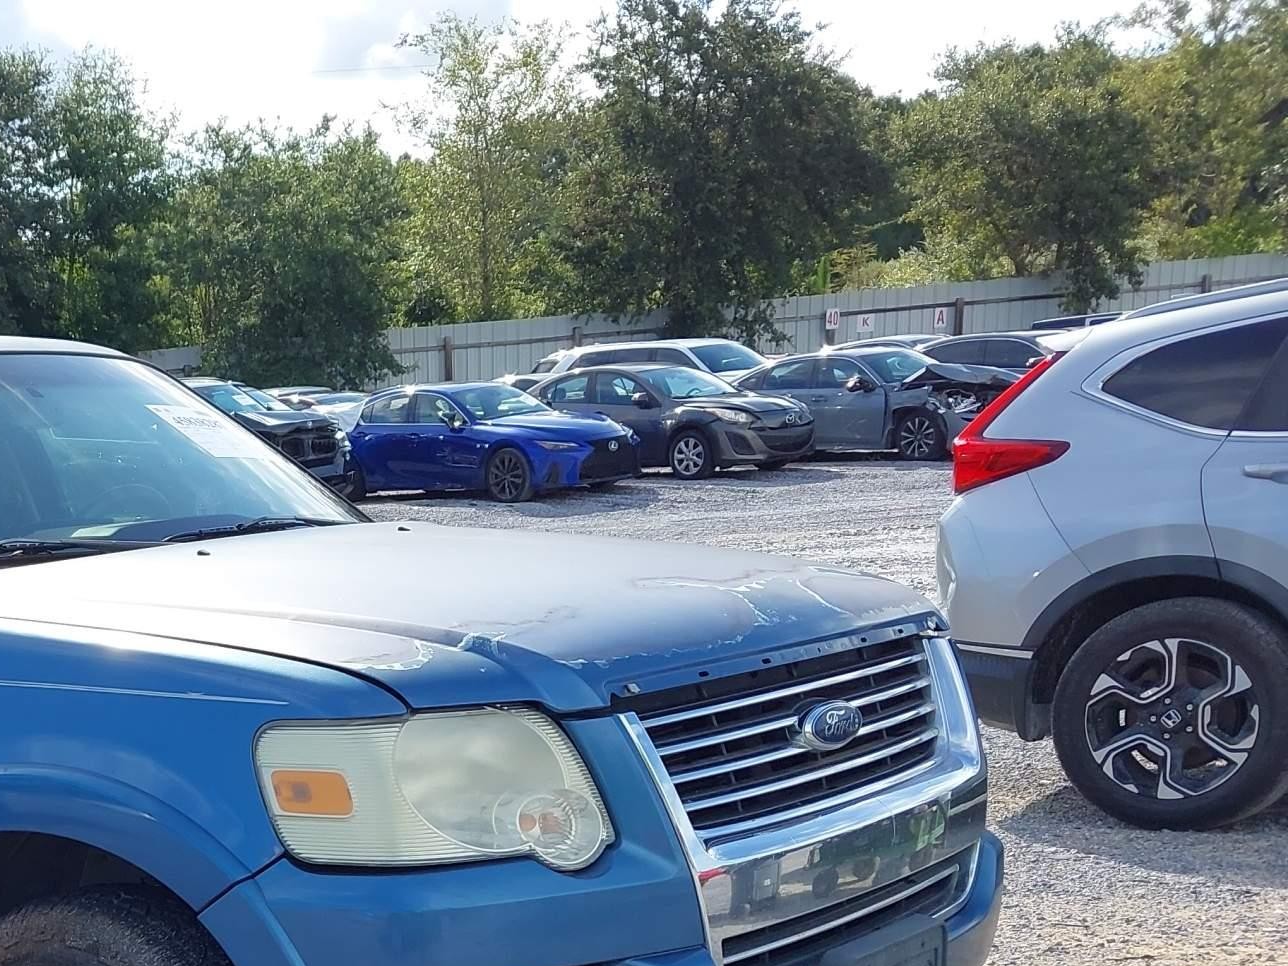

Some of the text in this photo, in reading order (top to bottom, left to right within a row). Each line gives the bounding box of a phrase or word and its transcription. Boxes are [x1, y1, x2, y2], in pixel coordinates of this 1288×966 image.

[827, 310, 839, 327] 40
[862, 316, 870, 328] K
[936, 309, 945, 325] A
[825, 709, 856, 737] Ford
